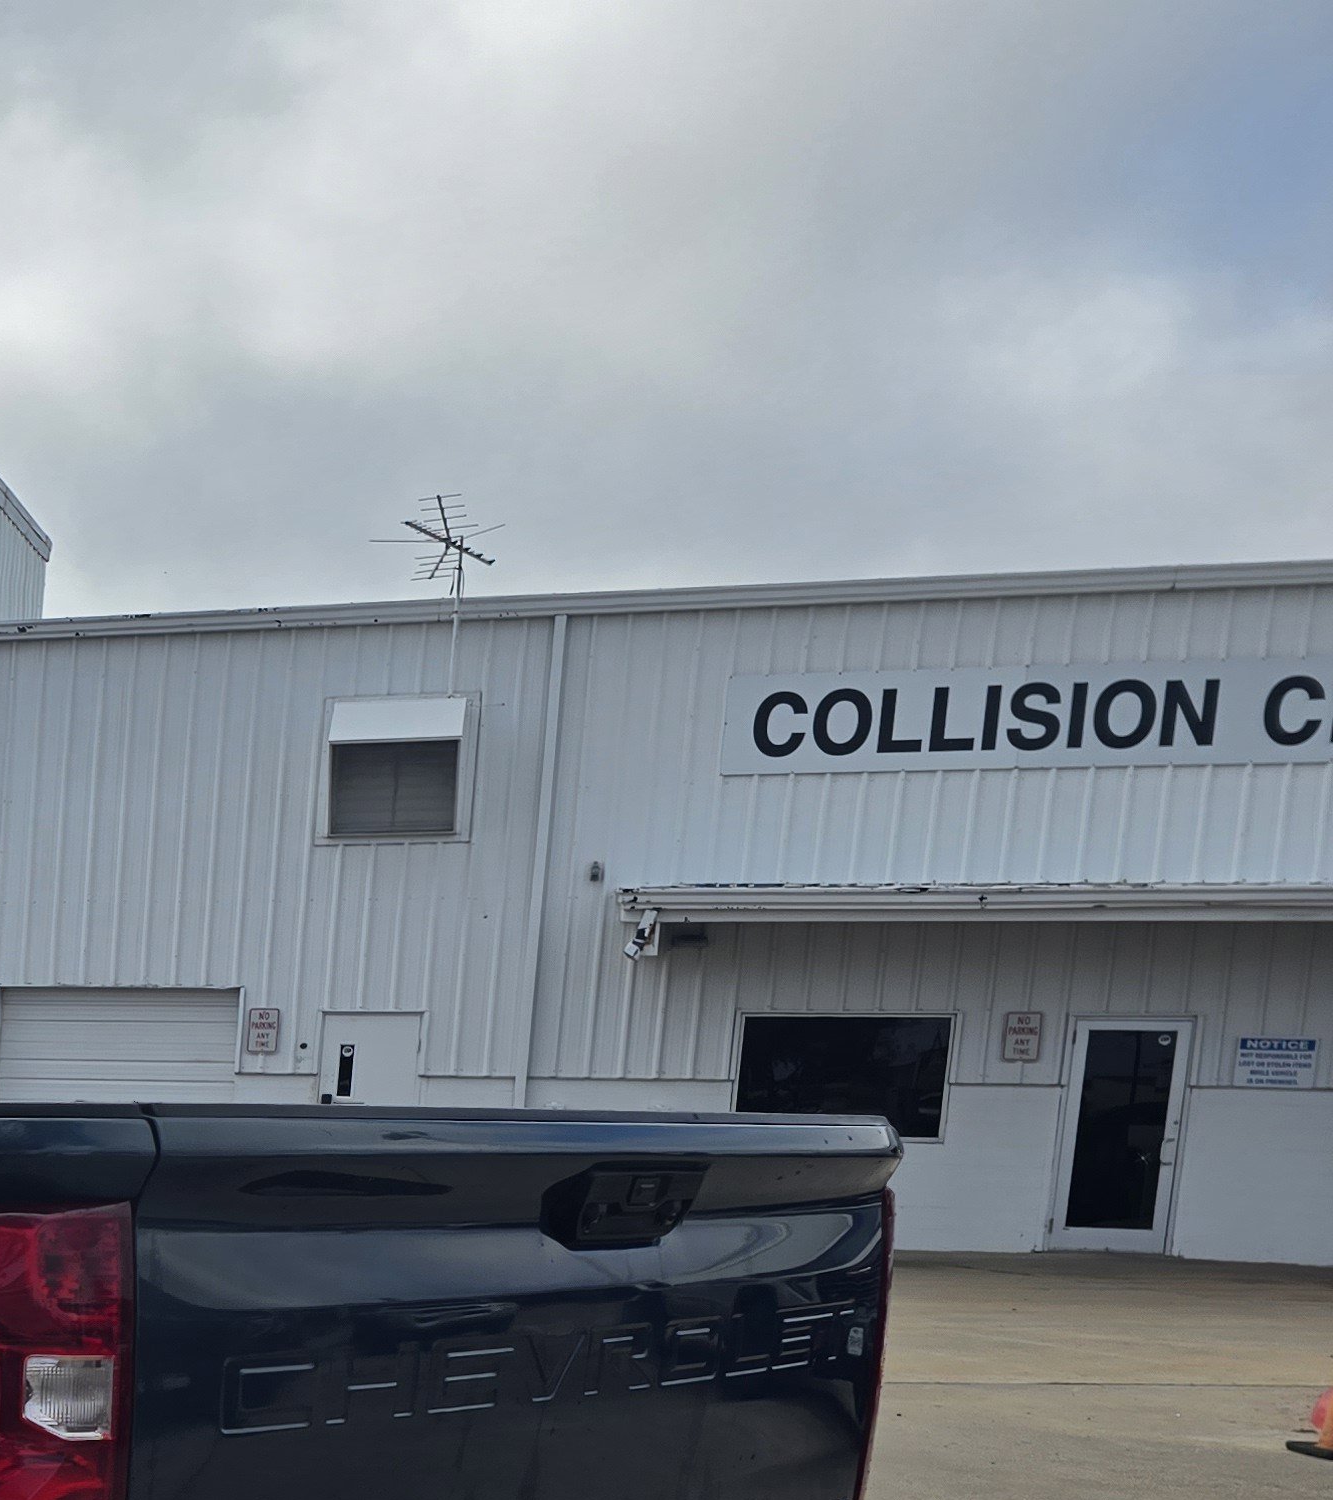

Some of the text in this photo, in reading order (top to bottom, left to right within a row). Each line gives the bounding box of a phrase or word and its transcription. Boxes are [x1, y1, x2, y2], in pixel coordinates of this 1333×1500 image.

[752, 674, 1333, 758] COLLISION C
[258, 1011, 271, 1020] NO
[1017, 1016, 1031, 1025] NO
[251, 1021, 277, 1030] PARKING
[1008, 1026, 1039, 1036] PARKING
[255, 1040, 270, 1049] TIME
[1014, 1038, 1030, 1046] ANY
[1246, 1040, 1310, 1050] NOTICE
[1013, 1047, 1030, 1056] TIME
[221, 1297, 855, 1434] CHEVROLET
